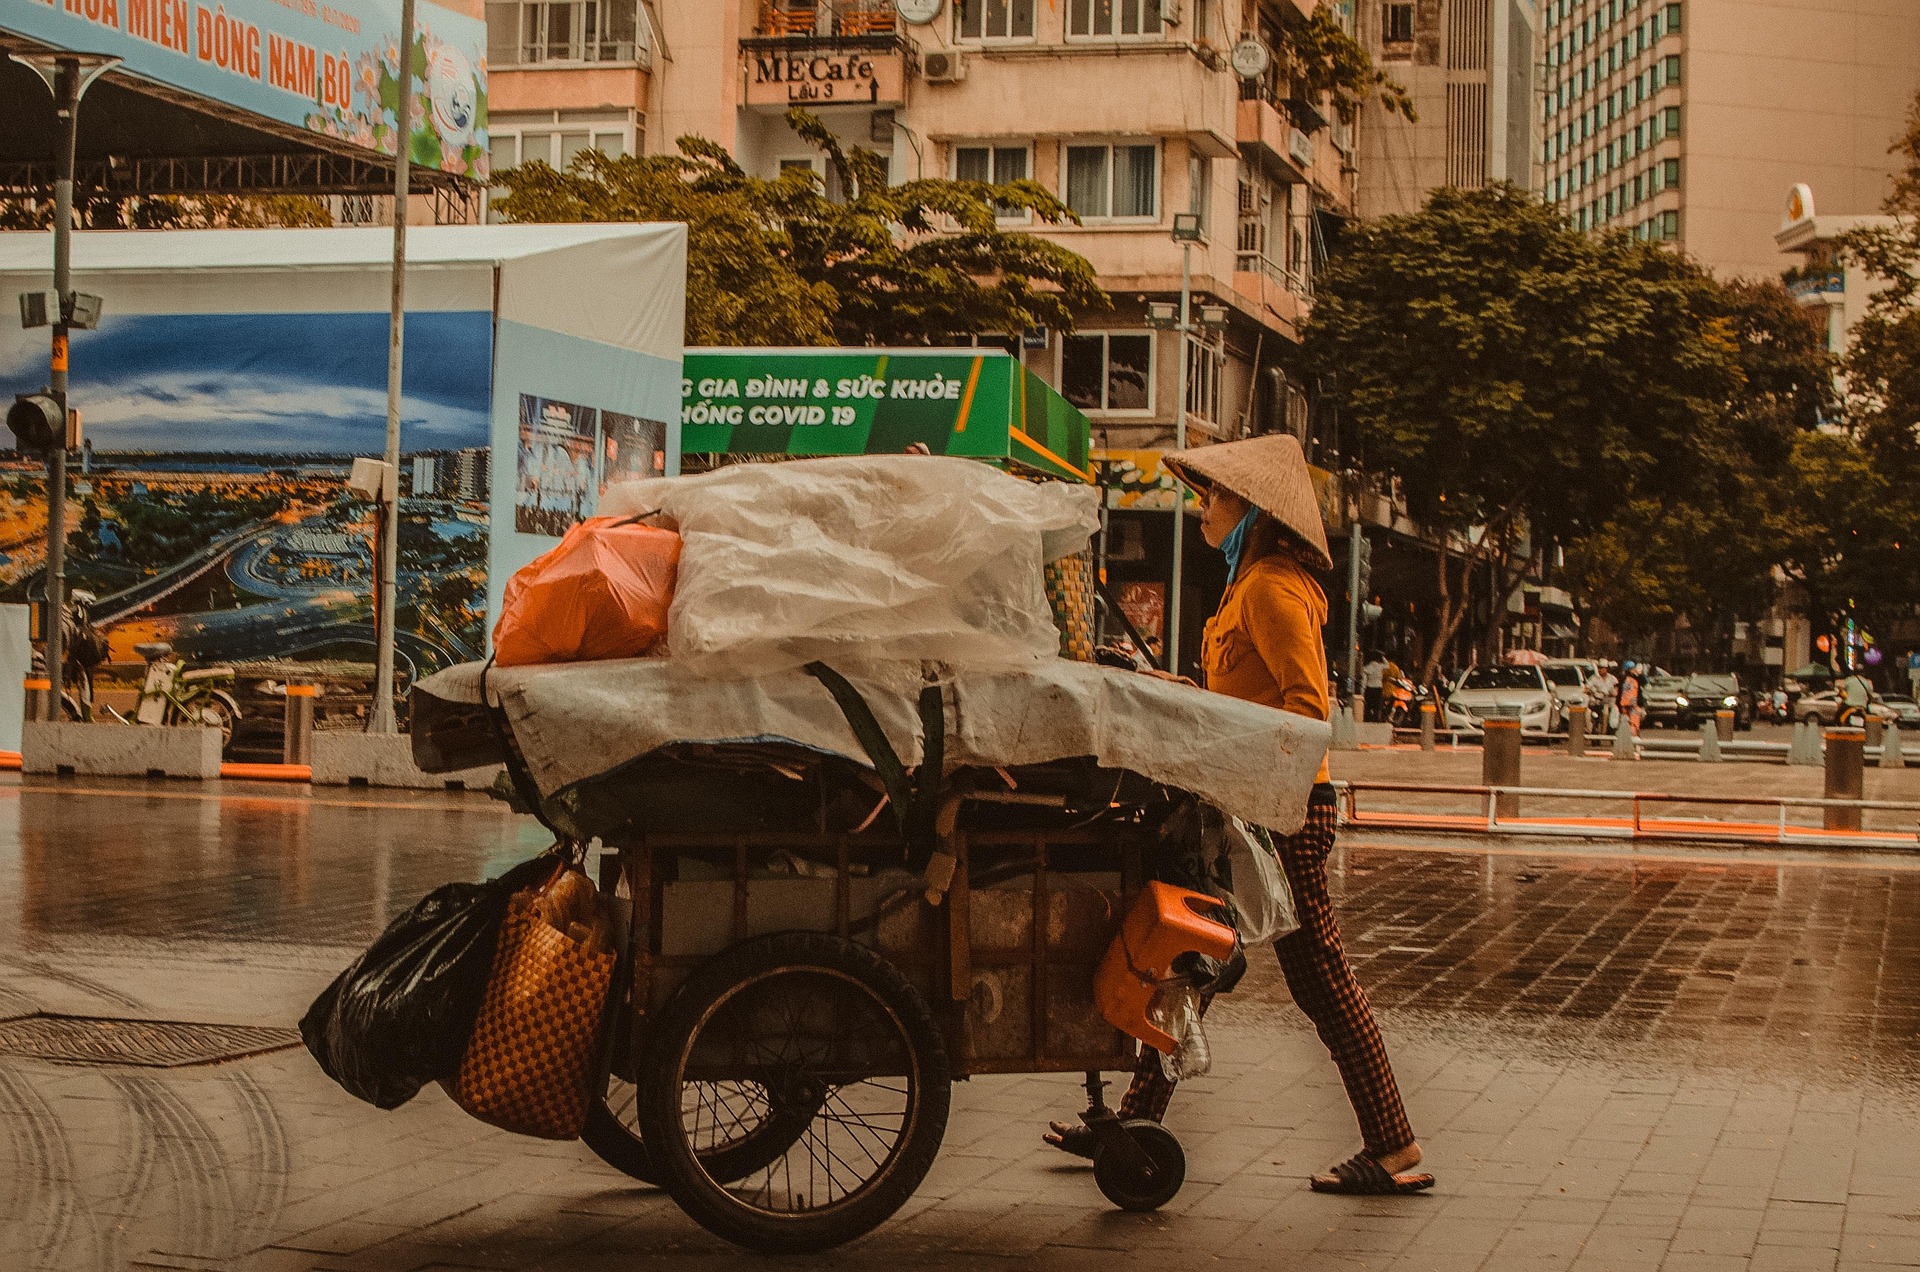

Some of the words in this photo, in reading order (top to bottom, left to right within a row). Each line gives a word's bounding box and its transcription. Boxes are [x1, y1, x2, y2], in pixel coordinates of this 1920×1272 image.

[197, 4, 261, 81] ĐÔNG
[268, 33, 316, 99] NAM
[823, 82, 834, 99] 3
[698, 378, 740, 398] GIA
[745, 373, 809, 399] ĐÌNH
[812, 378, 831, 399] &
[835, 374, 887, 399] SỨC
[890, 372, 962, 400] KHỎE
[748, 404, 826, 426] COVID
[831, 405, 857, 426] 19
